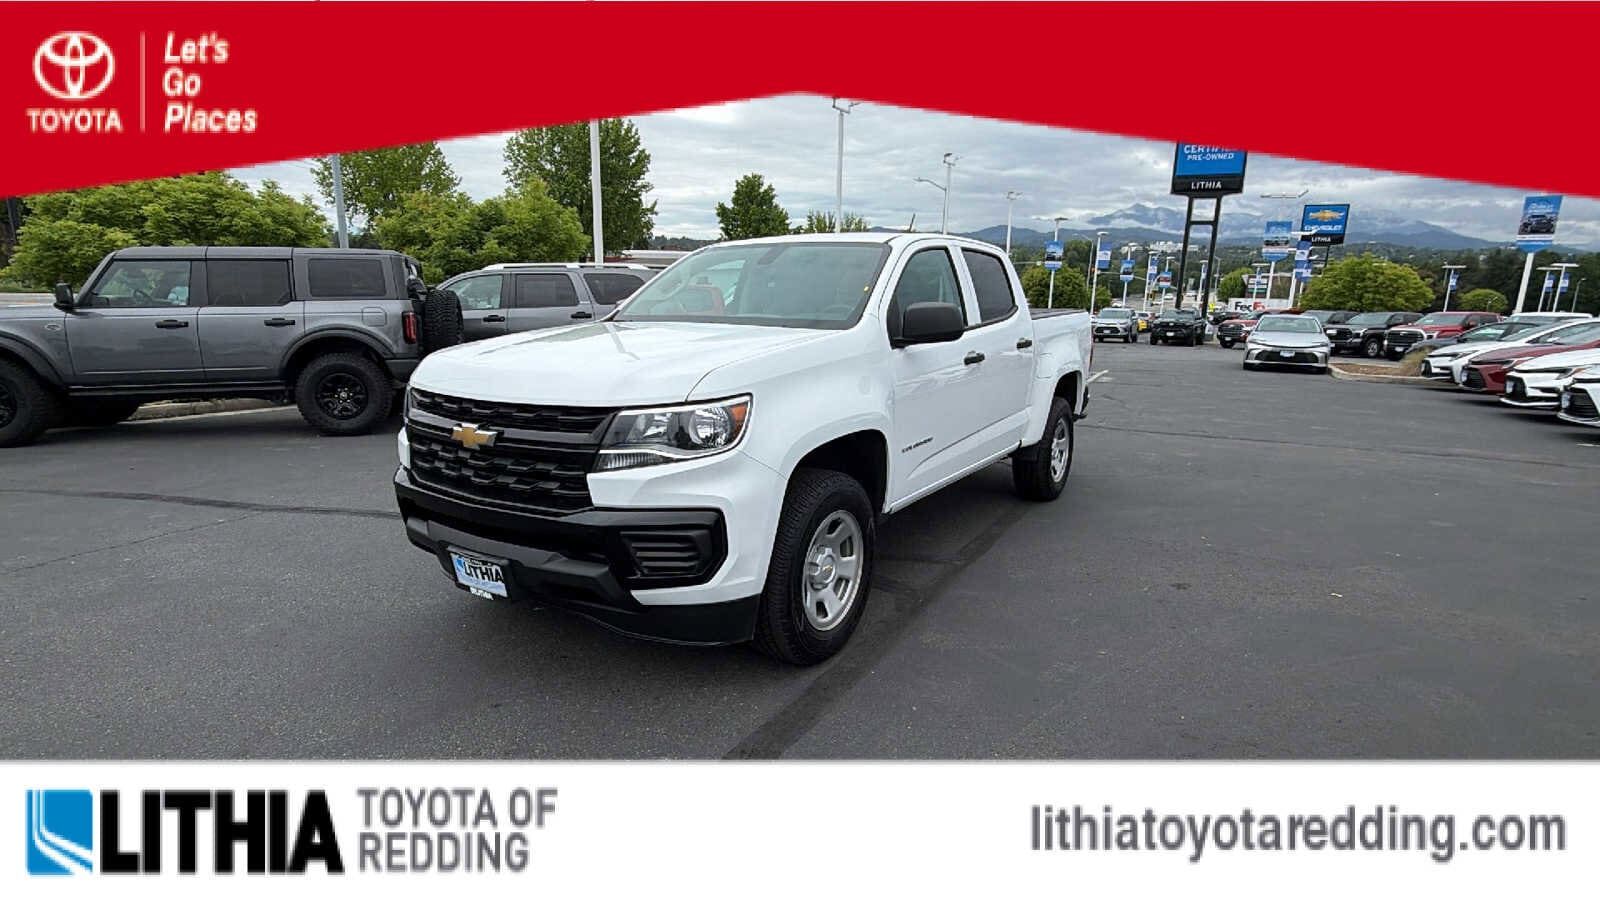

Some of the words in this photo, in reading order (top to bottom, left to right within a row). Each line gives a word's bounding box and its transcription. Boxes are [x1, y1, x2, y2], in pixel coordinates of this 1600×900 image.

[1184, 144, 1234, 153] CERTIFI
[1191, 181, 1222, 190] LITHIA
[464, 561, 504, 583] LITHIA
